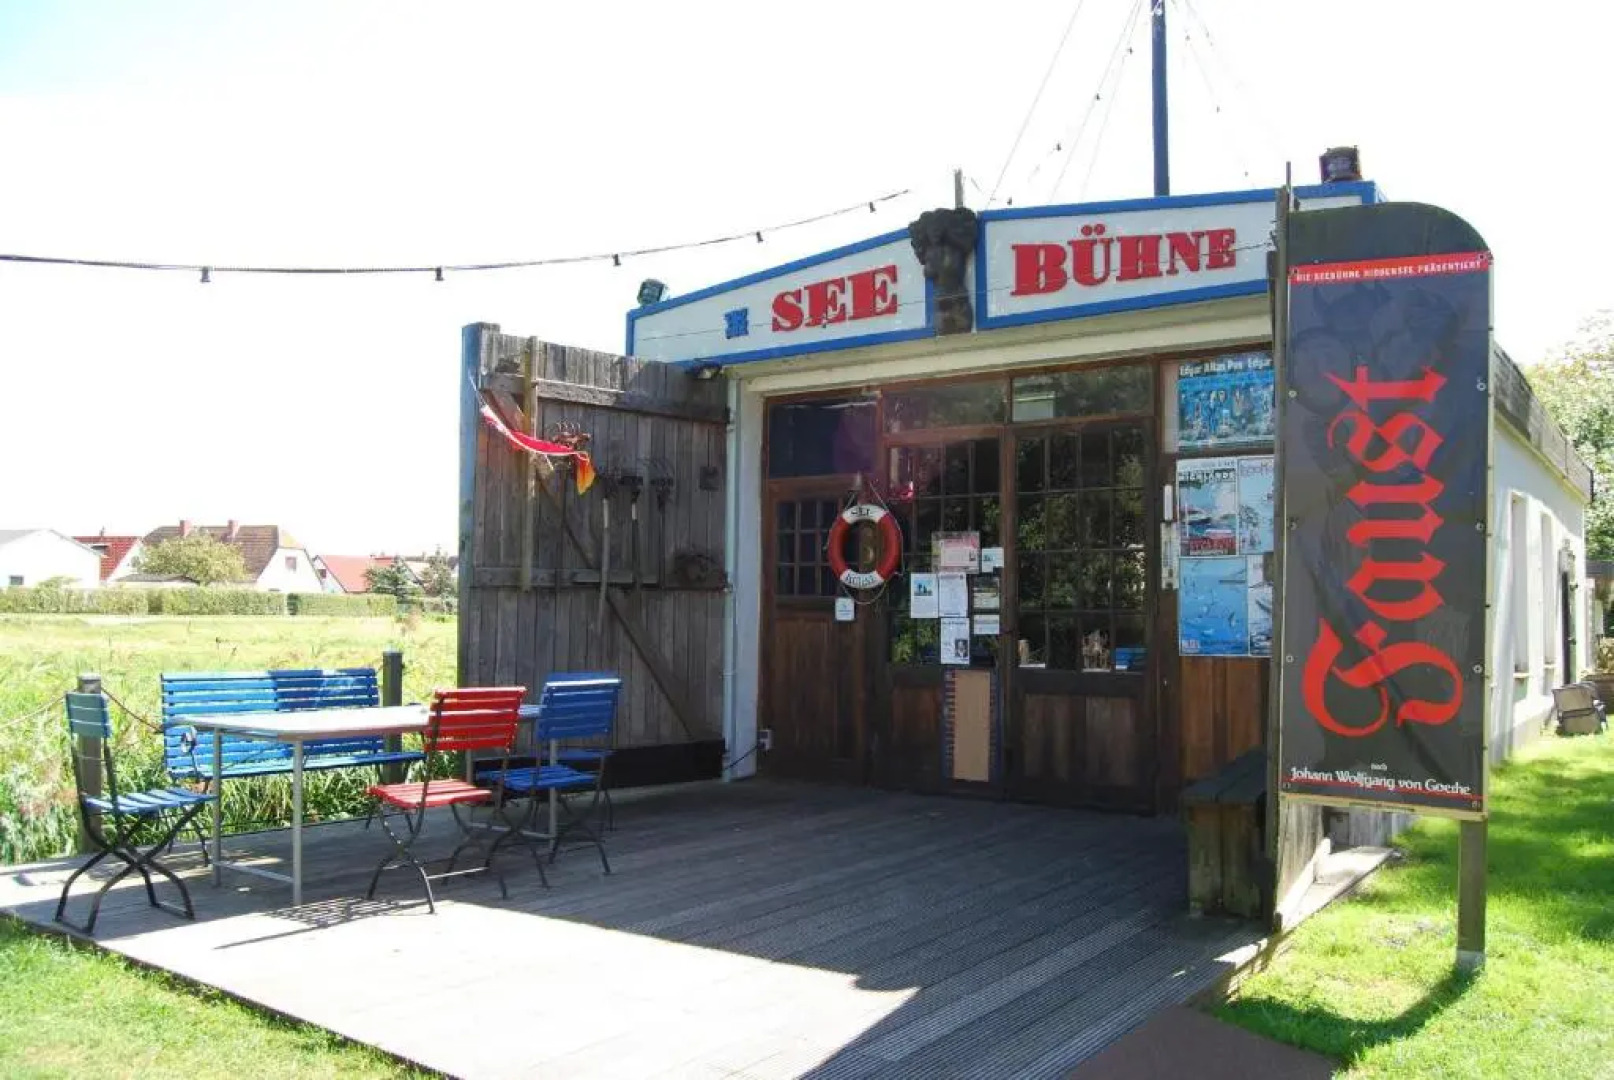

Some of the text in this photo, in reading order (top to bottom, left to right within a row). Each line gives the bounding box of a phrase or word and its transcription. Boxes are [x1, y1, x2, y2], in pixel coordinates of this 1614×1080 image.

[771, 264, 898, 332] SEE
[1010, 223, 1237, 297] BÜHNE
[1302, 364, 1464, 738] Faust
[1290, 766, 1471, 795] Johann Wolfgang von Goethe
